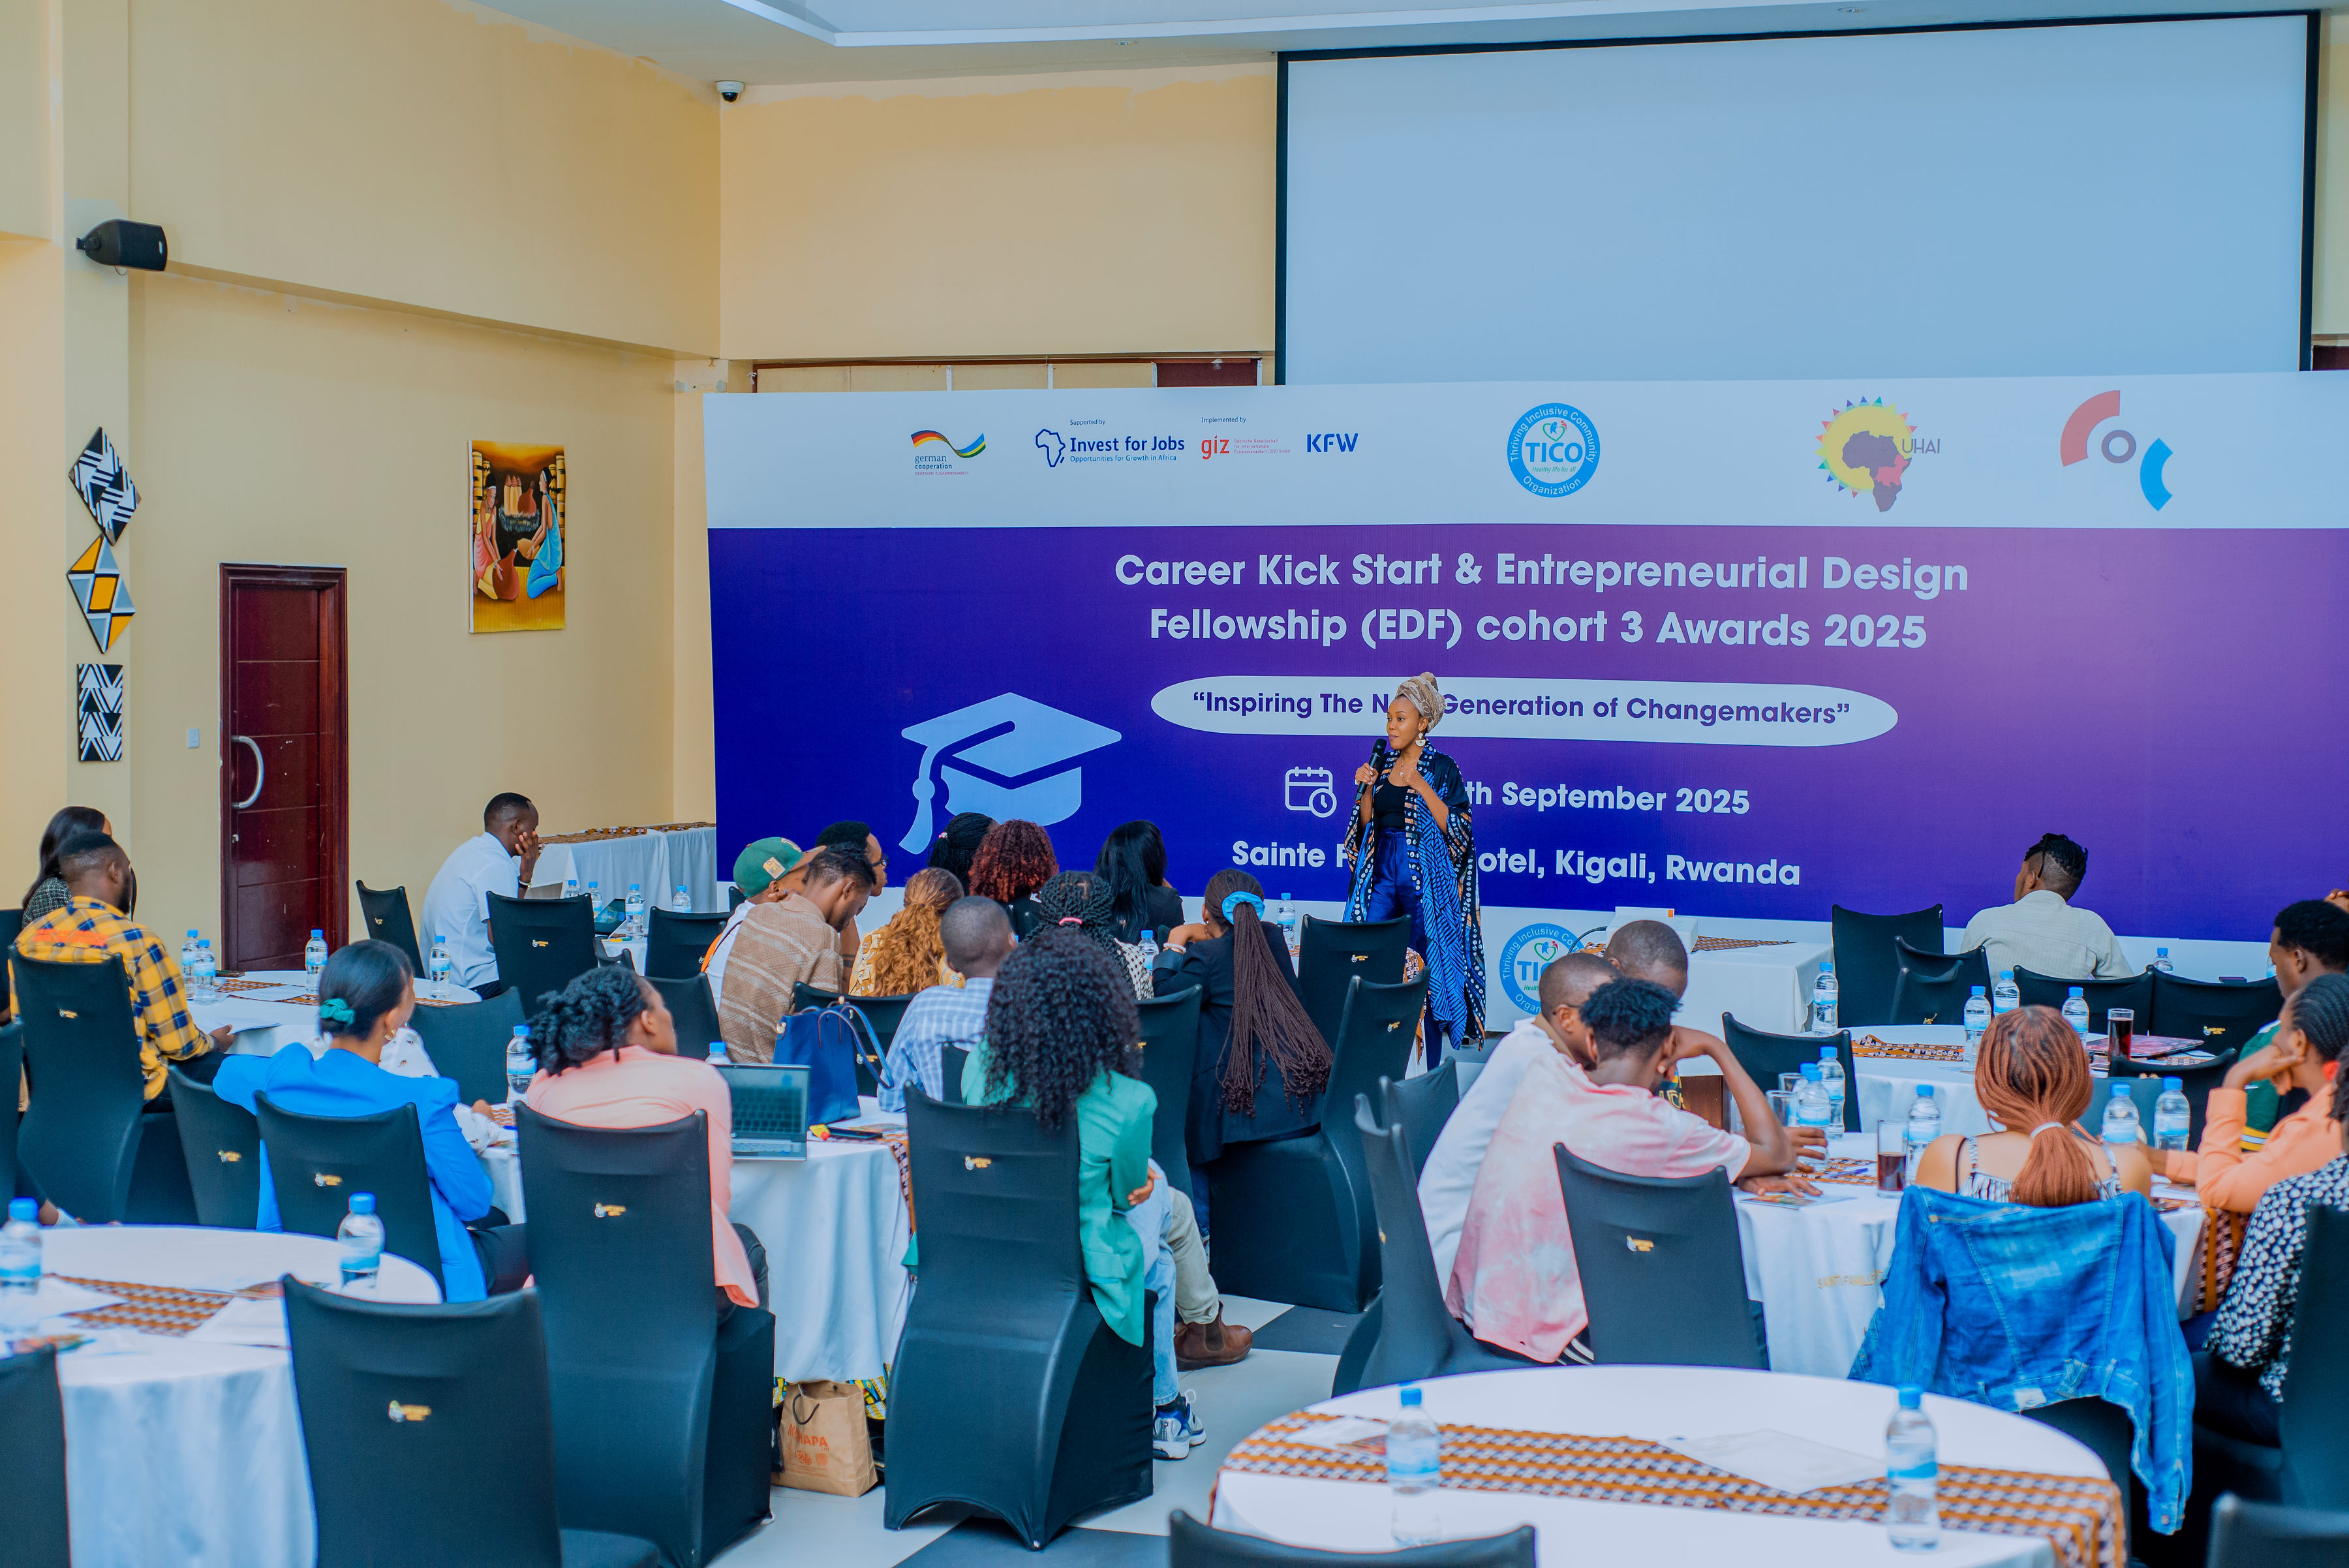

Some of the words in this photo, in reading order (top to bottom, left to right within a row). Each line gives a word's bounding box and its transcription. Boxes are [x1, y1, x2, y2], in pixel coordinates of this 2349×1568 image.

[1070, 437, 1119, 452] Invest
[1125, 436, 1147, 452] for
[1152, 435, 1185, 451] Jobs
[1201, 435, 1230, 460] giz
[1510, 423, 1529, 463] Thriving
[1525, 406, 1569, 424] Inclusive
[1571, 412, 1597, 463] Community
[1902, 438, 1941, 453] UHAI
[915, 455, 947, 464] german
[1525, 442, 1583, 463] TICO
[1523, 476, 1581, 495] Organization
[1115, 555, 1245, 585] Career
[1259, 555, 1340, 585] Kick
[1352, 553, 1442, 585] Start
[1454, 553, 1482, 585] &
[1497, 553, 1807, 592] Entrepreneurial
[1823, 556, 1969, 600] Design
[1151, 609, 1347, 647] Fellowship
[1361, 608, 1462, 650] (EDF)
[1477, 609, 1607, 642] cohort
[1620, 611, 1643, 643] 3
[1656, 612, 1810, 645] Awards
[1824, 614, 1927, 648] 2025
[1193, 692, 1312, 718] “Inspiring
[1320, 693, 1363, 714] The
[1443, 694, 1584, 716] Generation
[1593, 698, 1618, 718] of
[1627, 698, 1849, 726] Changemakers”
[1464, 781, 1492, 805] th
[1501, 782, 1666, 812] September
[1676, 788, 1750, 814] 2025
[1233, 840, 1325, 867] Sainte
[1478, 848, 1544, 879] otel,
[1556, 850, 1655, 884] Kigali,
[1667, 854, 1800, 885] Rwanda
[1503, 941, 1520, 979] Thriving
[1517, 927, 1559, 942] Inclusive
[1516, 961, 1552, 981] TI
